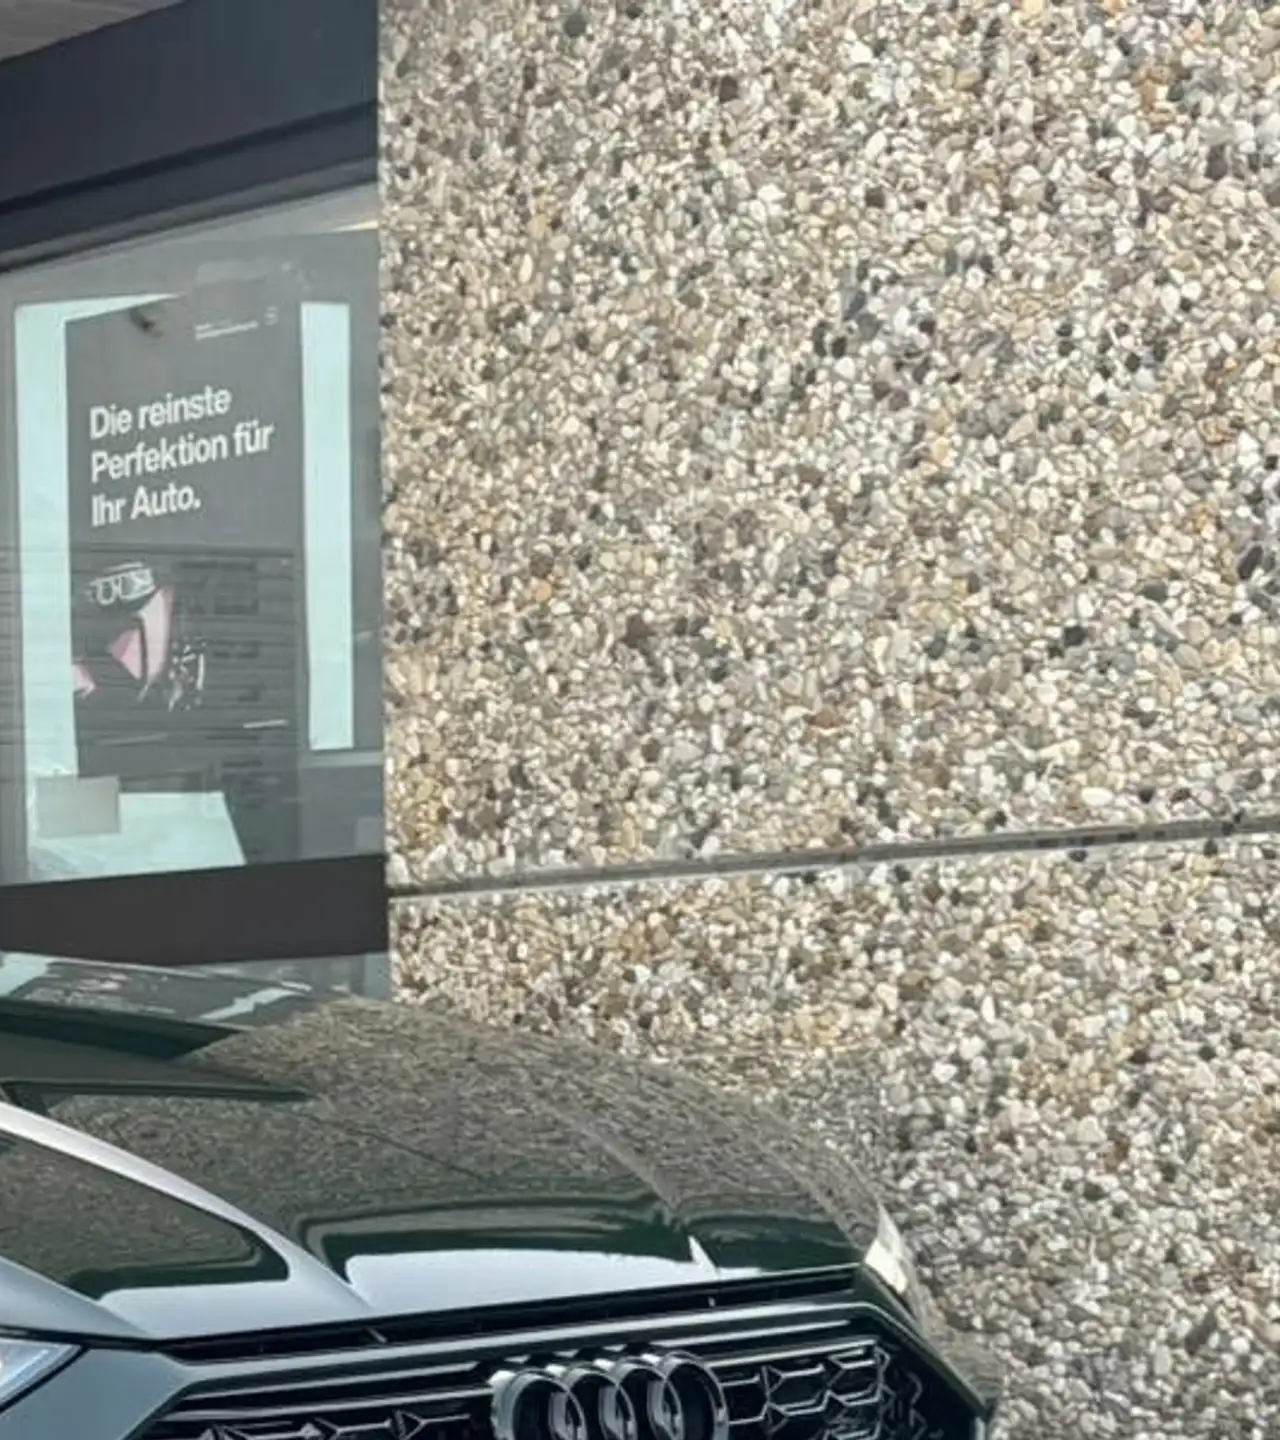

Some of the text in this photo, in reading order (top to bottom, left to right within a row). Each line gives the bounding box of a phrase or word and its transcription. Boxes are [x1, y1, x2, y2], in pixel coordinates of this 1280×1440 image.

[90, 384, 233, 440] Die reinste
[91, 419, 275, 484] Perfektion für
[92, 482, 203, 527] Ihr Auto.
